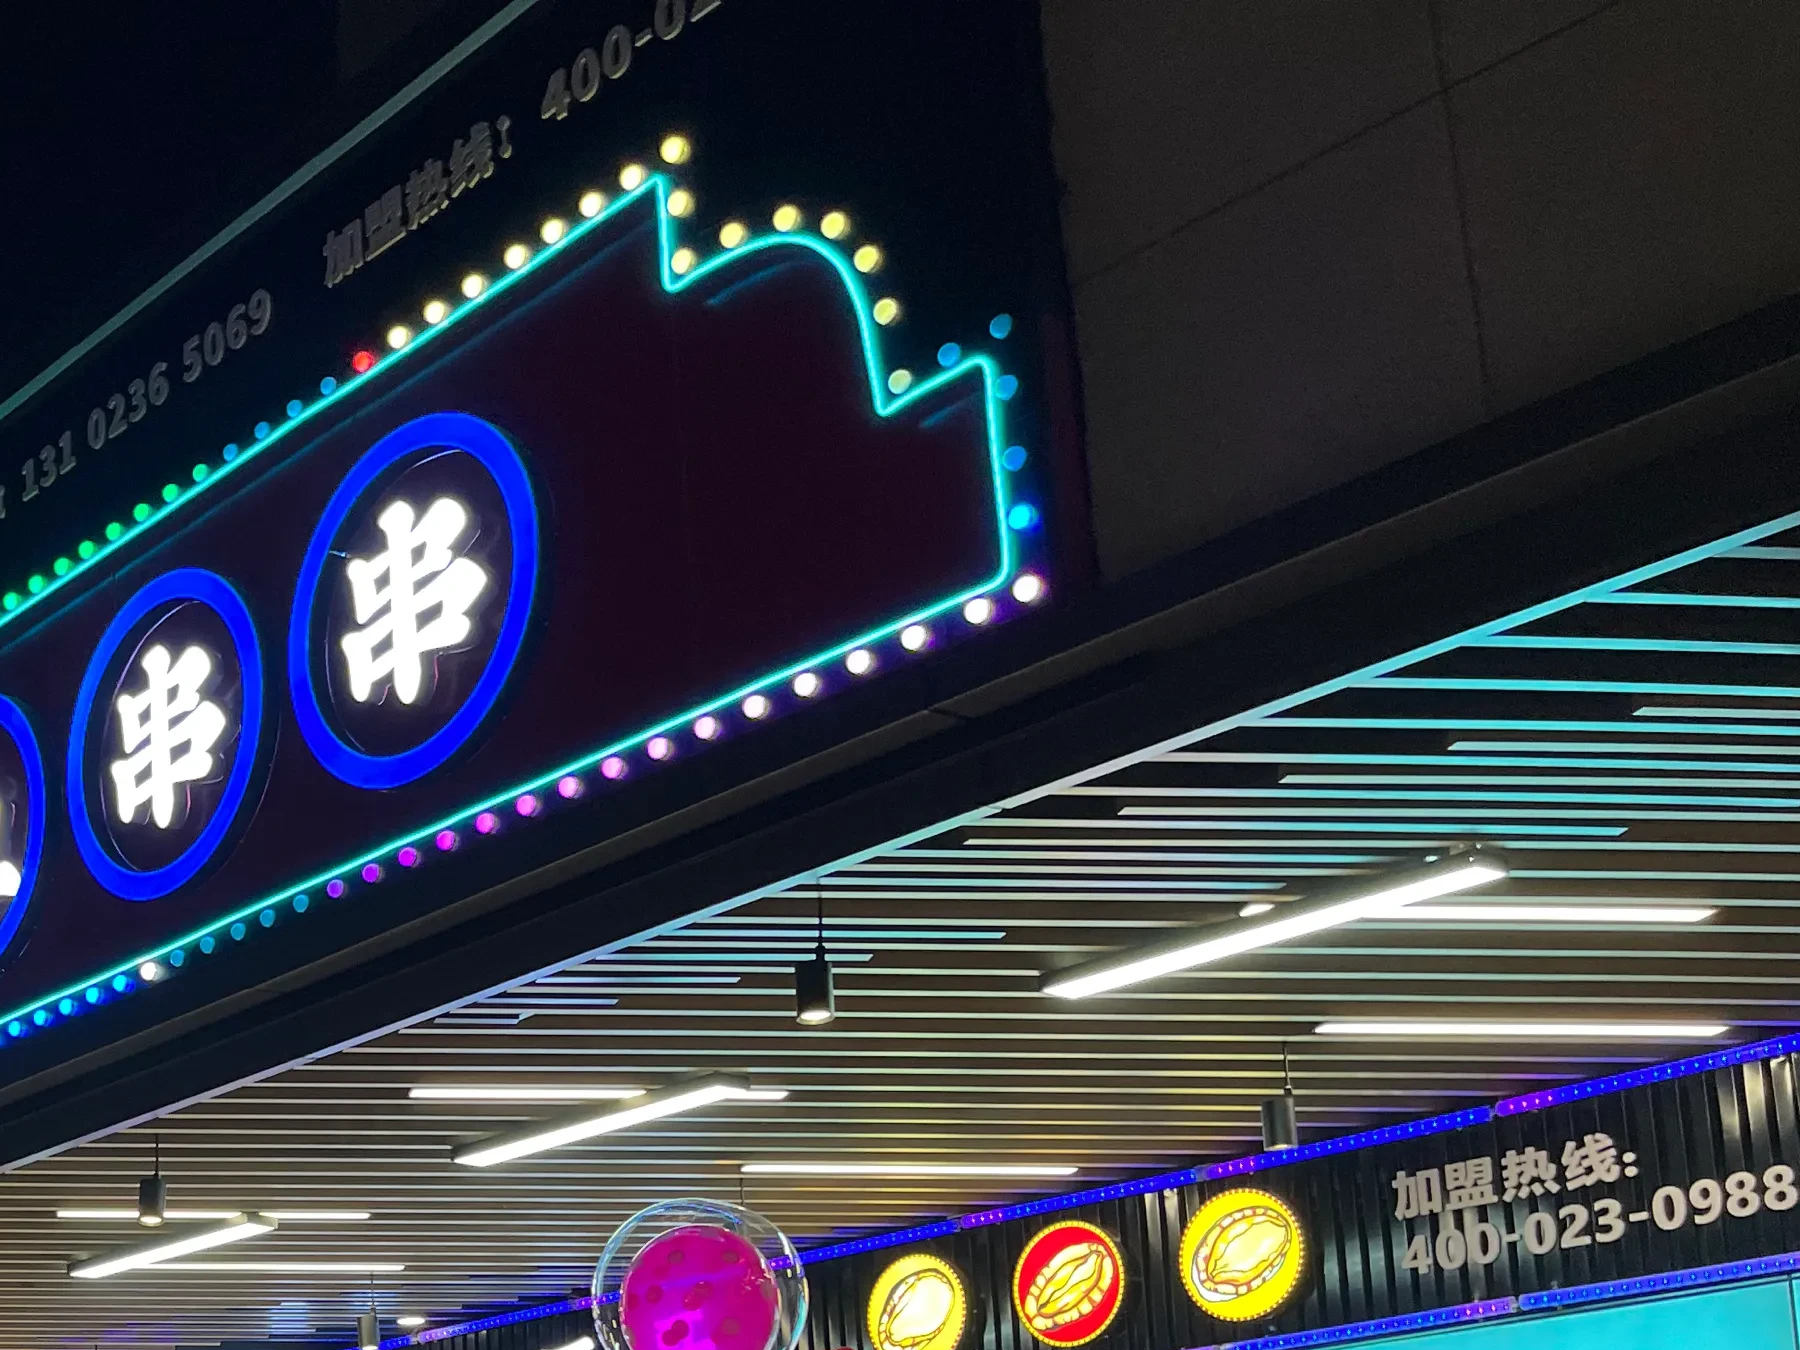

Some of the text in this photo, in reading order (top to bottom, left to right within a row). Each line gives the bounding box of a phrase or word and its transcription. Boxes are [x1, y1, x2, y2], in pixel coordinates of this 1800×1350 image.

[20, 434, 78, 504] 131
[87, 362, 169, 447] 0236
[183, 289, 273, 383] 5069
[1392, 1133, 1638, 1220] 加盟热线：
[1401, 1165, 1799, 1275] 400-023-0988
